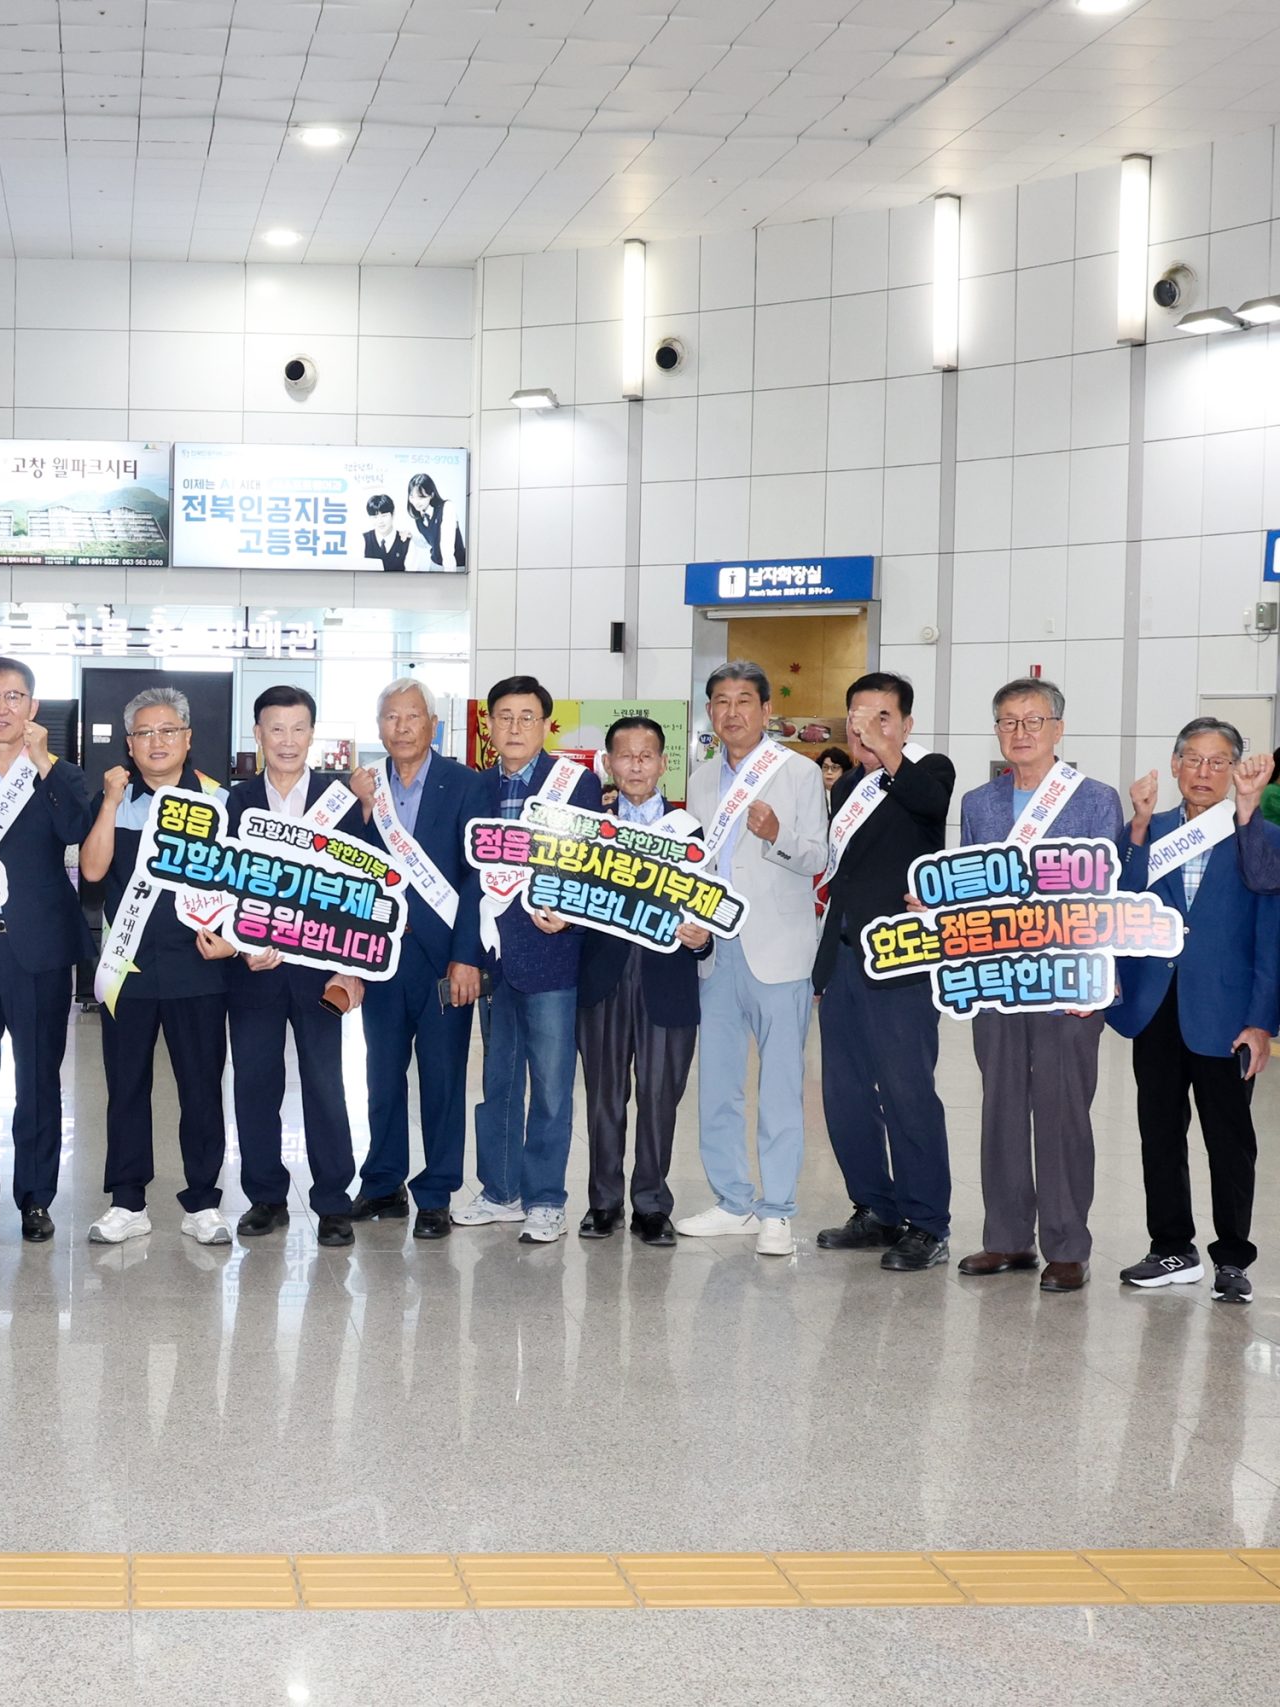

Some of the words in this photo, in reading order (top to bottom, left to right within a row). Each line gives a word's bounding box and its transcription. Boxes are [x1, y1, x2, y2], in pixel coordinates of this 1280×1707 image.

[11, 457, 46, 479] 고창
[51, 457, 139, 480] 웰파크시티
[183, 478, 215, 490] 이제는
[240, 479, 261, 491] 시대
[181, 495, 348, 525] 전북인공지능
[238, 528, 348, 557] 고등학교
[748, 565, 822, 587] 남자화장실
[161, 799, 215, 839] 정읍
[326, 789, 348, 813] 고향
[706, 788, 750, 851] 환영합니다
[834, 801, 865, 843] 한가위
[248, 817, 314, 849] 고향사랑
[326, 840, 390, 879] 착한기부
[389, 830, 437, 889] 환영합니다
[616, 827, 688, 863] 착한기부
[151, 833, 394, 924] 고향사랑기부제를
[920, 850, 1031, 905] 아들아,
[1035, 847, 1109, 892] 딸아
[237, 897, 387, 964] 응원합니다!
[531, 873, 681, 943] 응원합니다!
[872, 921, 941, 970] 효도는
[942, 956, 1103, 1010] 부탁한다!
